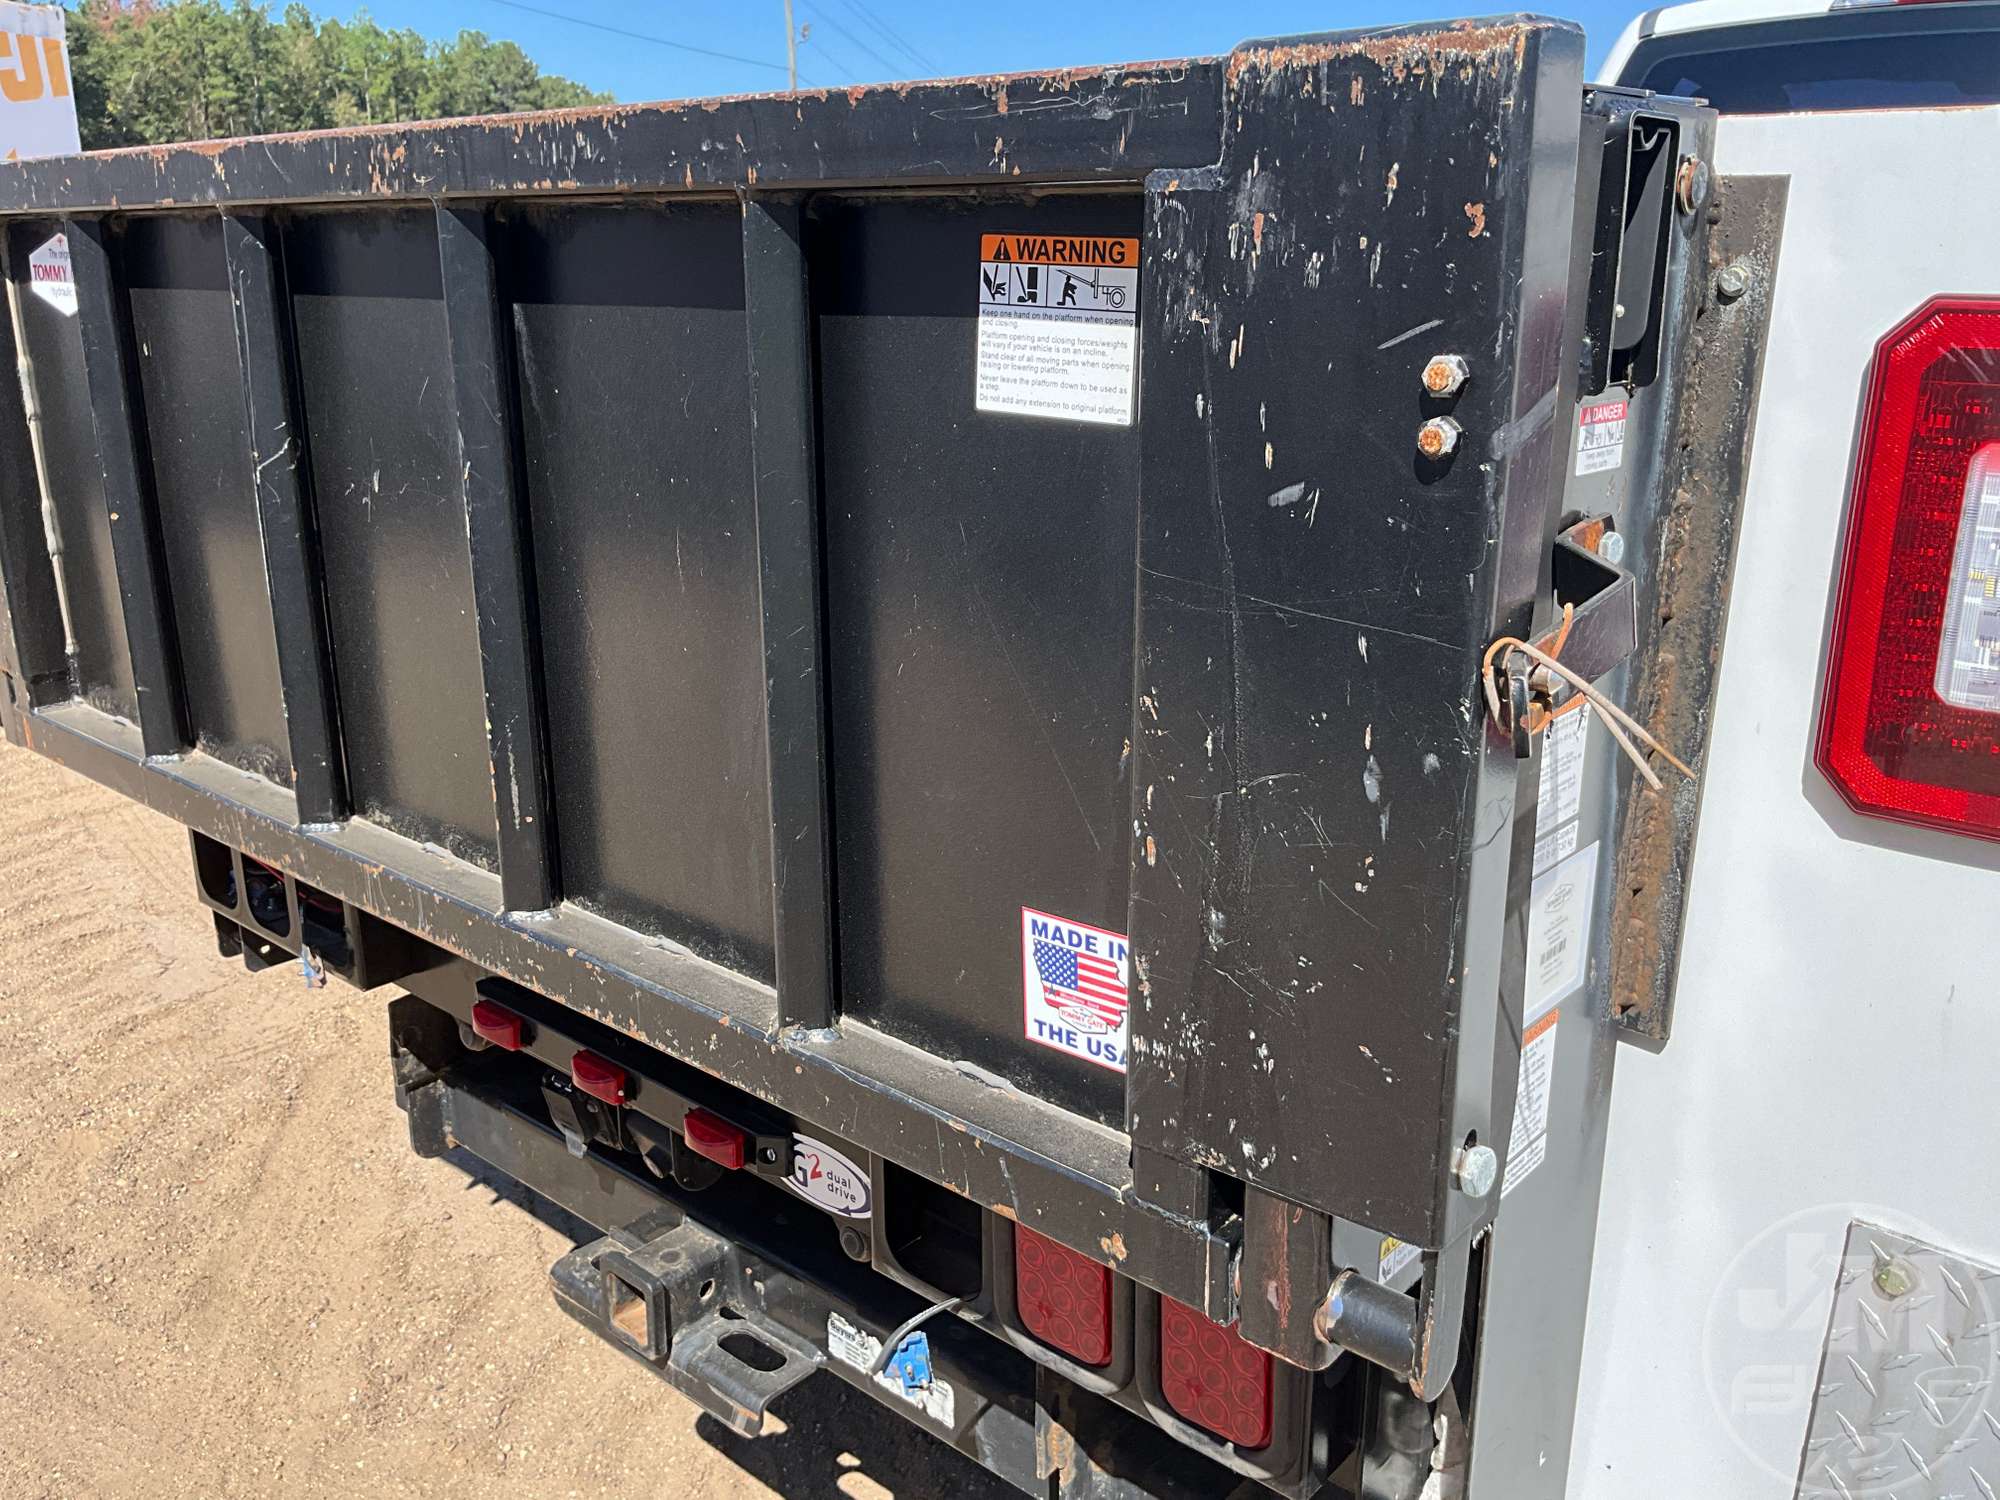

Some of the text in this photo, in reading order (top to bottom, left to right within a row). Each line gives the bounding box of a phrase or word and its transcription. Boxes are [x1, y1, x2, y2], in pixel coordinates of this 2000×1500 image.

[1016, 237, 1126, 264] WARNING
[32, 263, 67, 282] TOMMY
[982, 308, 998, 318] Keep
[1014, 310, 1030, 319] hand
[1042, 312, 1053, 321] the
[1054, 313, 1083, 324] platform
[1085, 315, 1103, 324] when
[1105, 317, 1134, 327] opening
[980, 373, 999, 382] Never
[1000, 375, 1018, 384] leave
[1019, 377, 1029, 385] the
[1031, 379, 1059, 388] platform
[1060, 381, 1078, 390] down
[1080, 383, 1087, 391] to
[1089, 384, 1098, 392] be
[1100, 386, 1118, 394] used
[979, 392, 989, 401] Do
[1001, 396, 1014, 404] add
[1015, 398, 1027, 407] any
[1029, 399, 1060, 409] extension
[1071, 403, 1096, 413] original
[1098, 404, 1128, 415] platform
[1593, 403, 1624, 422] DANGER
[1031, 918, 1099, 954] MADE
[1034, 1019, 1079, 1049] THE
[826, 1171, 851, 1189] dual
[827, 1183, 857, 1203] drive
